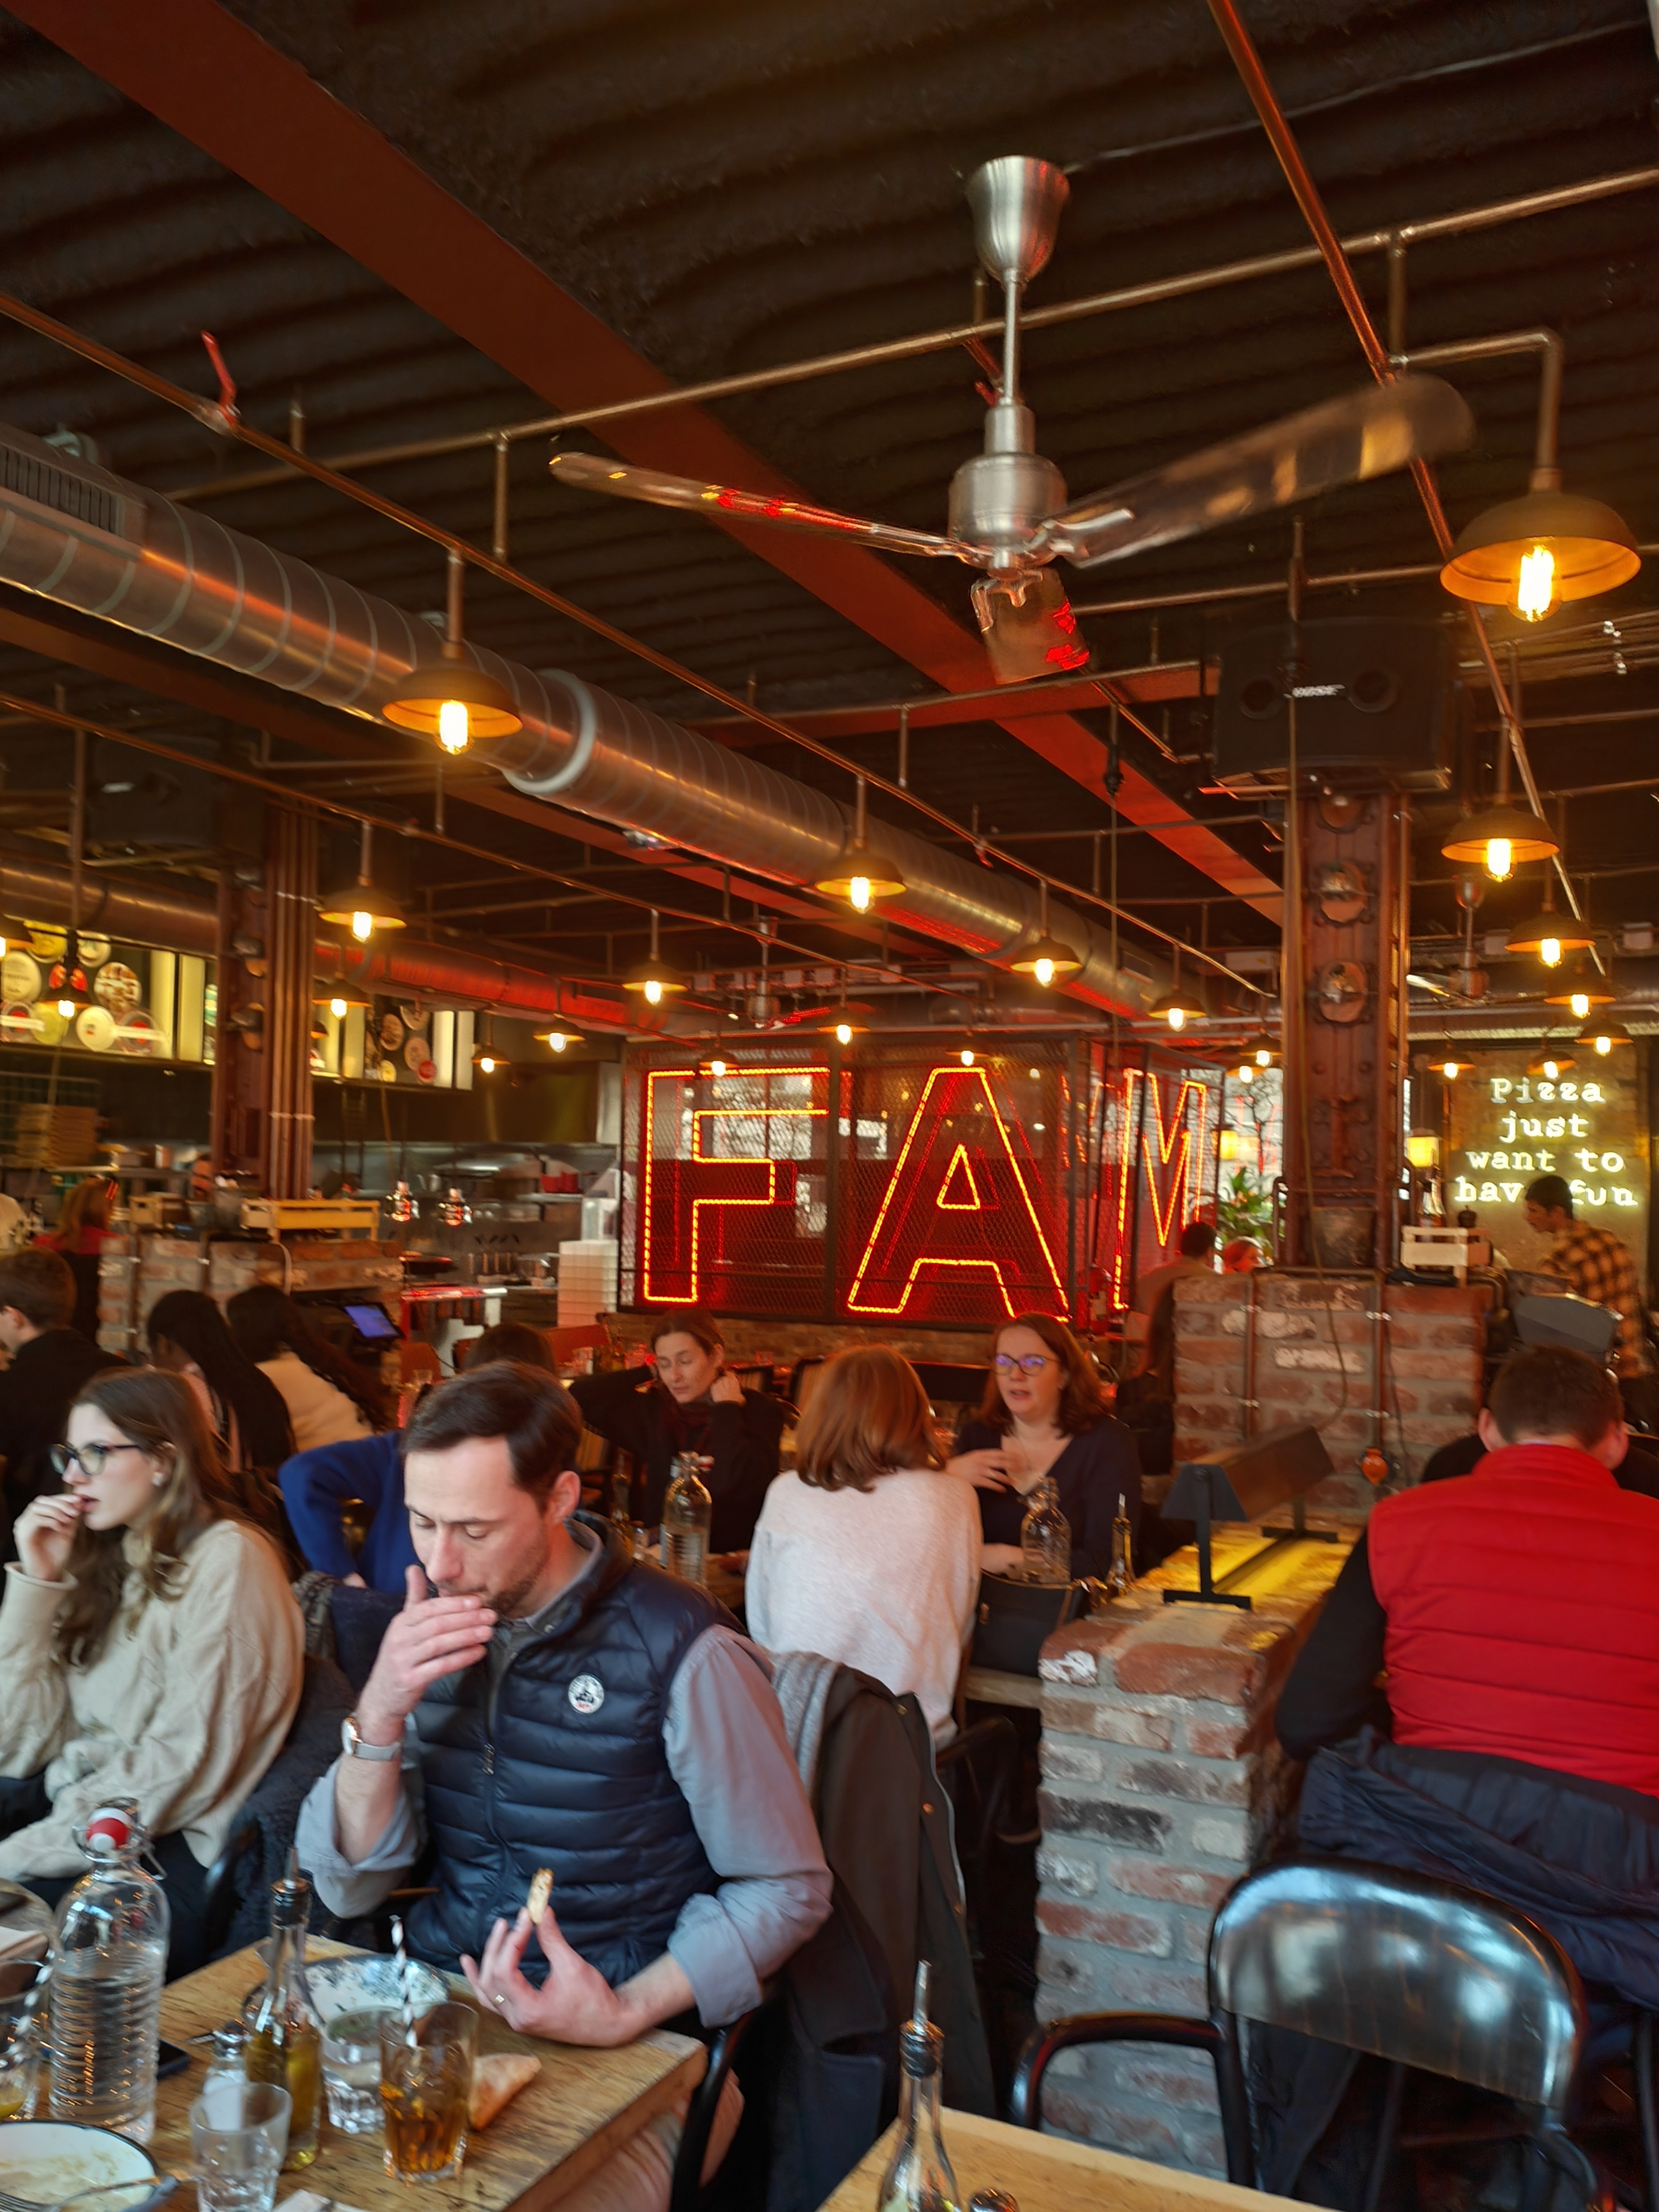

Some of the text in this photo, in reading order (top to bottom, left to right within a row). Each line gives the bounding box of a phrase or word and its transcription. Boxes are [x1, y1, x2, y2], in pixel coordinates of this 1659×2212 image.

[1490, 1077, 1606, 1104] Pizza
[1499, 1110, 1589, 1143] just
[1465, 1148, 1626, 1173] want to
[1455, 1176, 1525, 1203] hav
